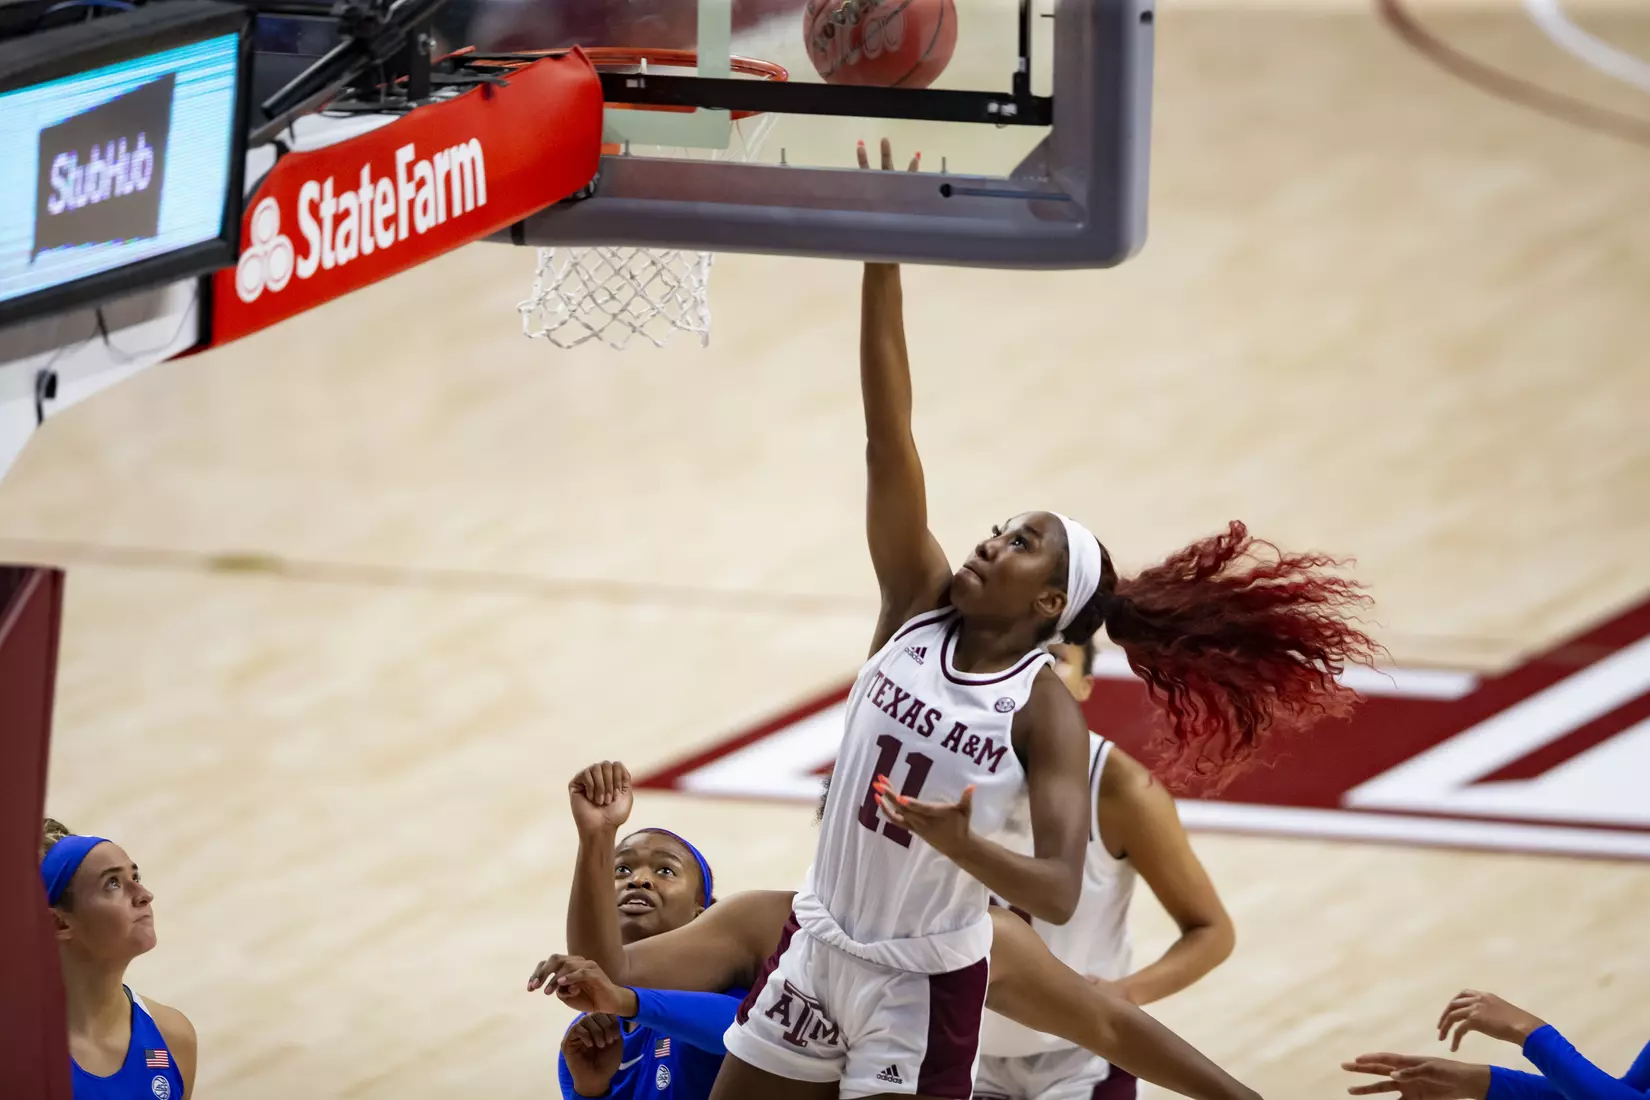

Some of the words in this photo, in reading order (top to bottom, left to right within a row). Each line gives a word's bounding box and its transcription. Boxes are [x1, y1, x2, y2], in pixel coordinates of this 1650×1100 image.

[48, 133, 154, 214] StubHub
[904, 646, 925, 666] adidas
[867, 671, 943, 738] TEXAS
[940, 721, 1008, 774] A&M
[857, 734, 934, 849] 11
[876, 1072, 903, 1085] adidas
